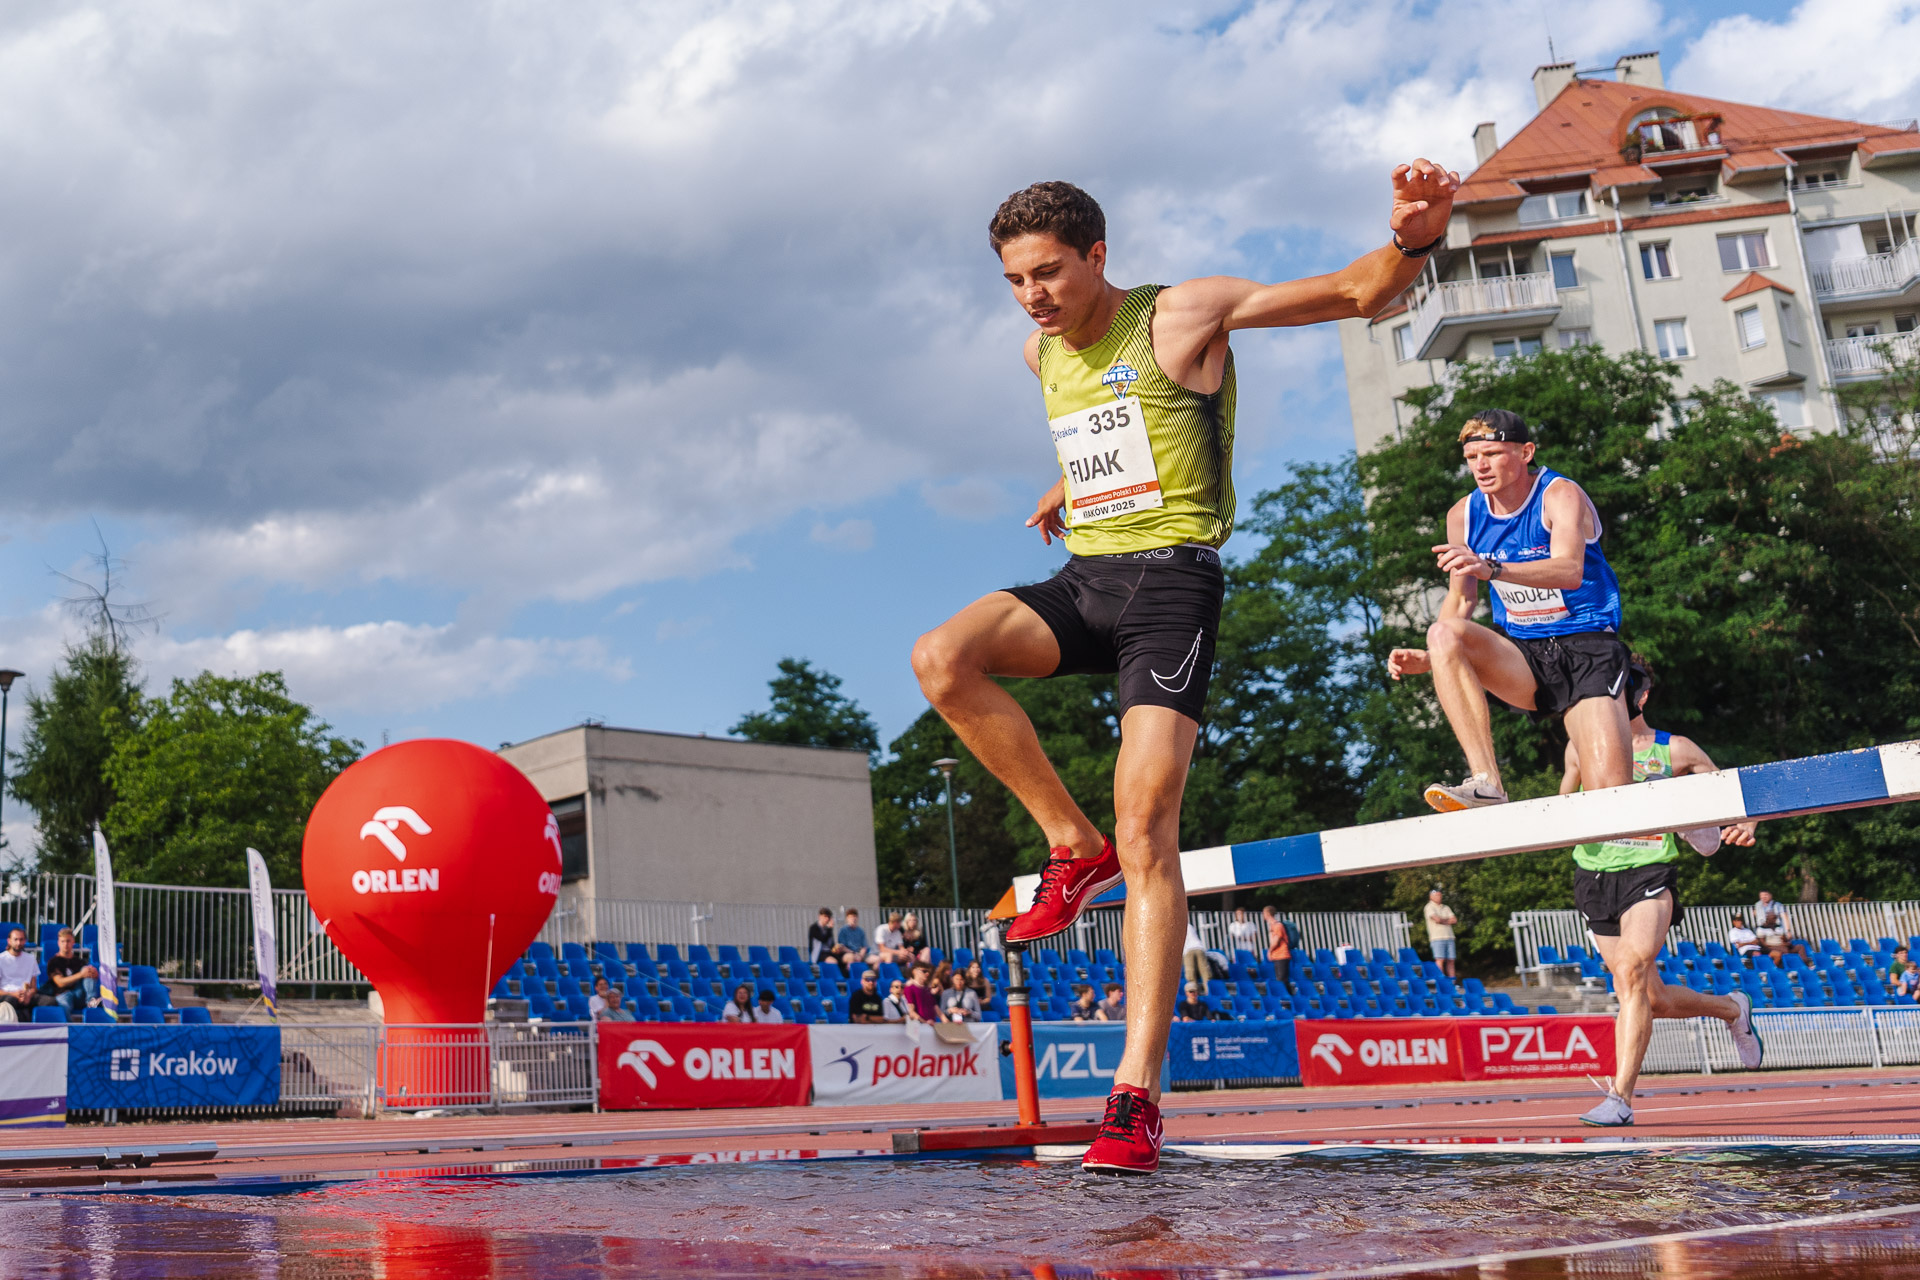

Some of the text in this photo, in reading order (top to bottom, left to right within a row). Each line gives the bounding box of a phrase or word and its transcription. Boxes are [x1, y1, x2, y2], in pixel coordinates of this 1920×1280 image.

[1102, 369, 1138, 385] MKS
[1056, 426, 1079, 439] Kraków
[1088, 405, 1131, 435] 335
[1069, 448, 1125, 484] FIJAK
[1112, 489, 1132, 498] Polski
[1132, 485, 1147, 493] U23
[1083, 500, 1136, 518] KRAKÓW 2025
[352, 868, 439, 894] ORLEN
[1360, 1038, 1448, 1067] ORLEN
[1480, 1025, 1598, 1062] PZLA
[149, 1050, 238, 1076] Kraków
[683, 1048, 796, 1080] ORLEN
[871, 1045, 979, 1085] polanik
